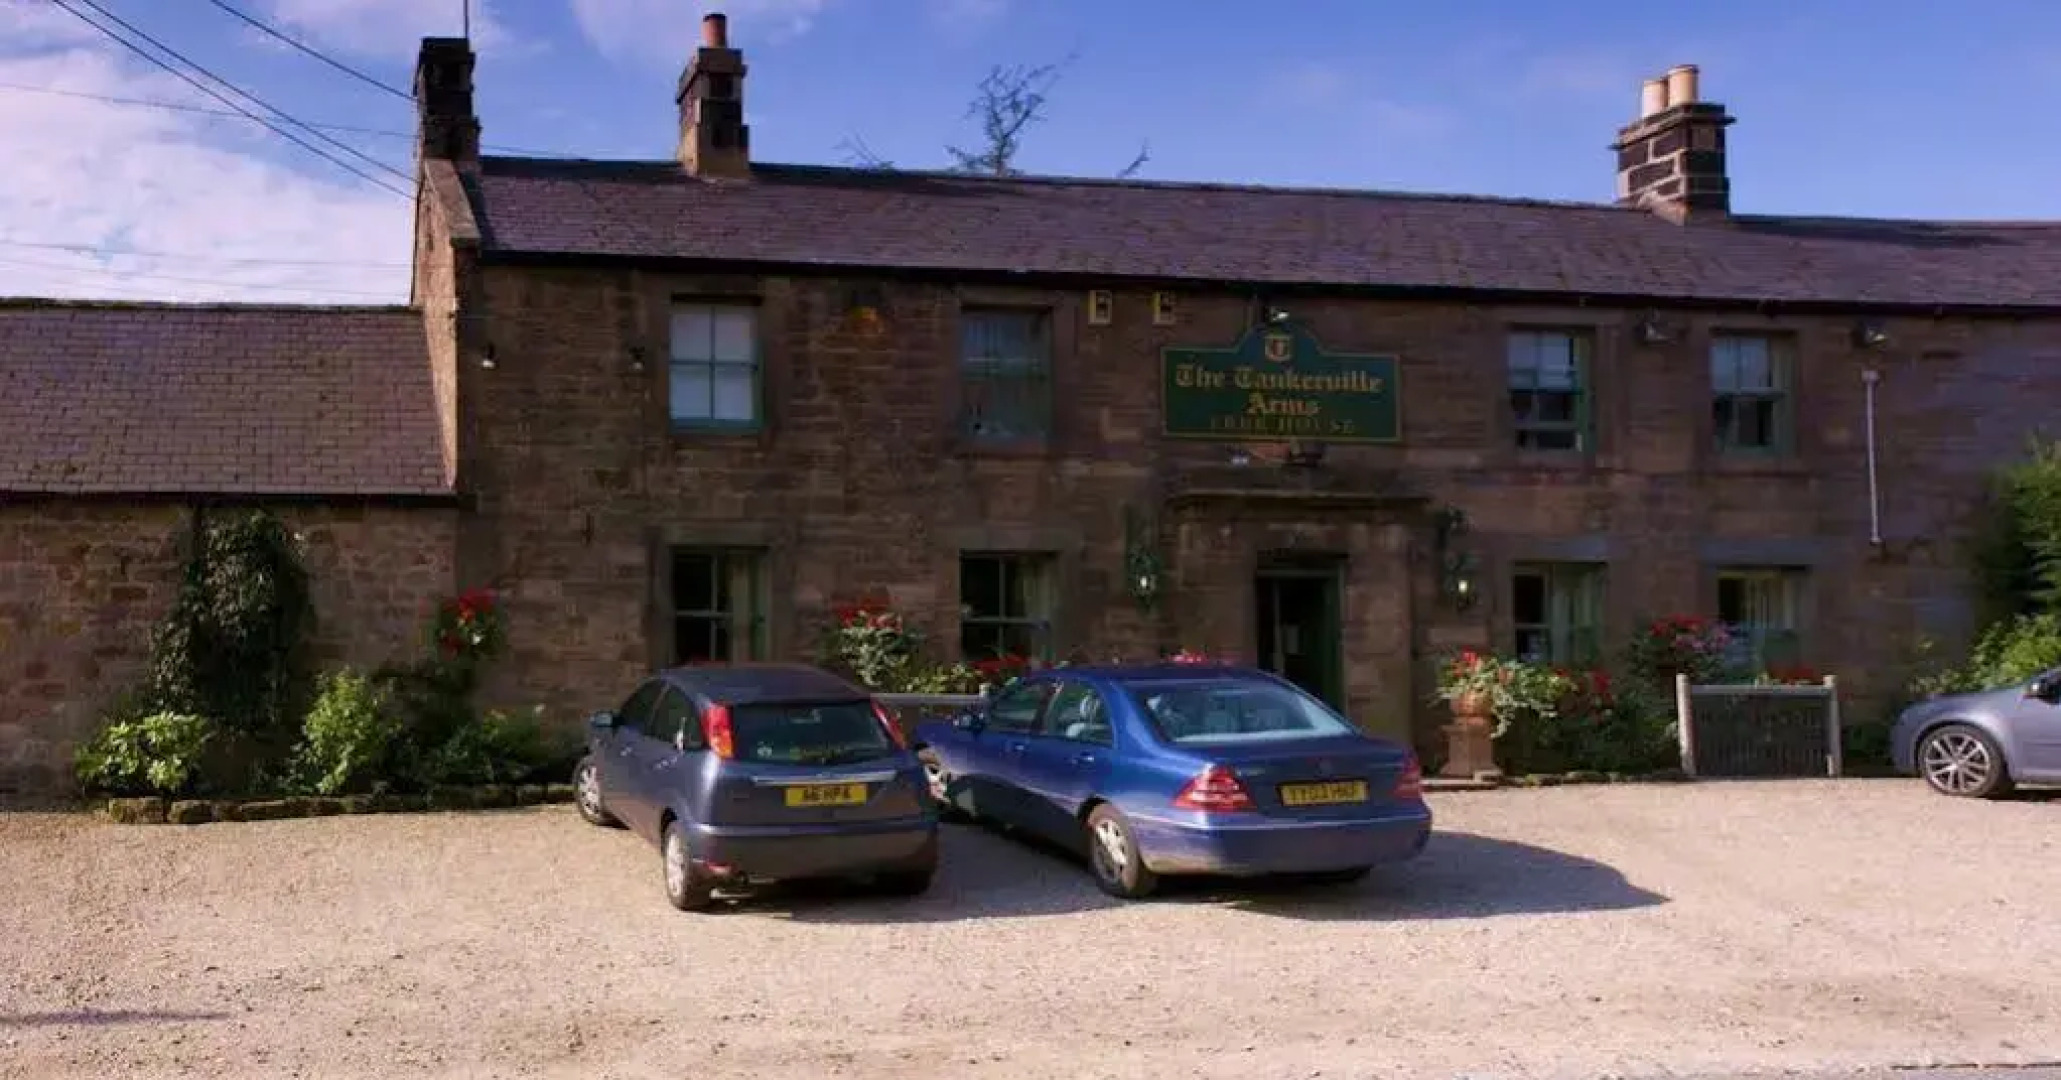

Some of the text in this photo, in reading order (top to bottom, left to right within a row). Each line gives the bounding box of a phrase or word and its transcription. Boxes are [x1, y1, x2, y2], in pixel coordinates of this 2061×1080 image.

[1176, 363, 1385, 393] The Tankerville
[1247, 392, 1321, 414] Arms
